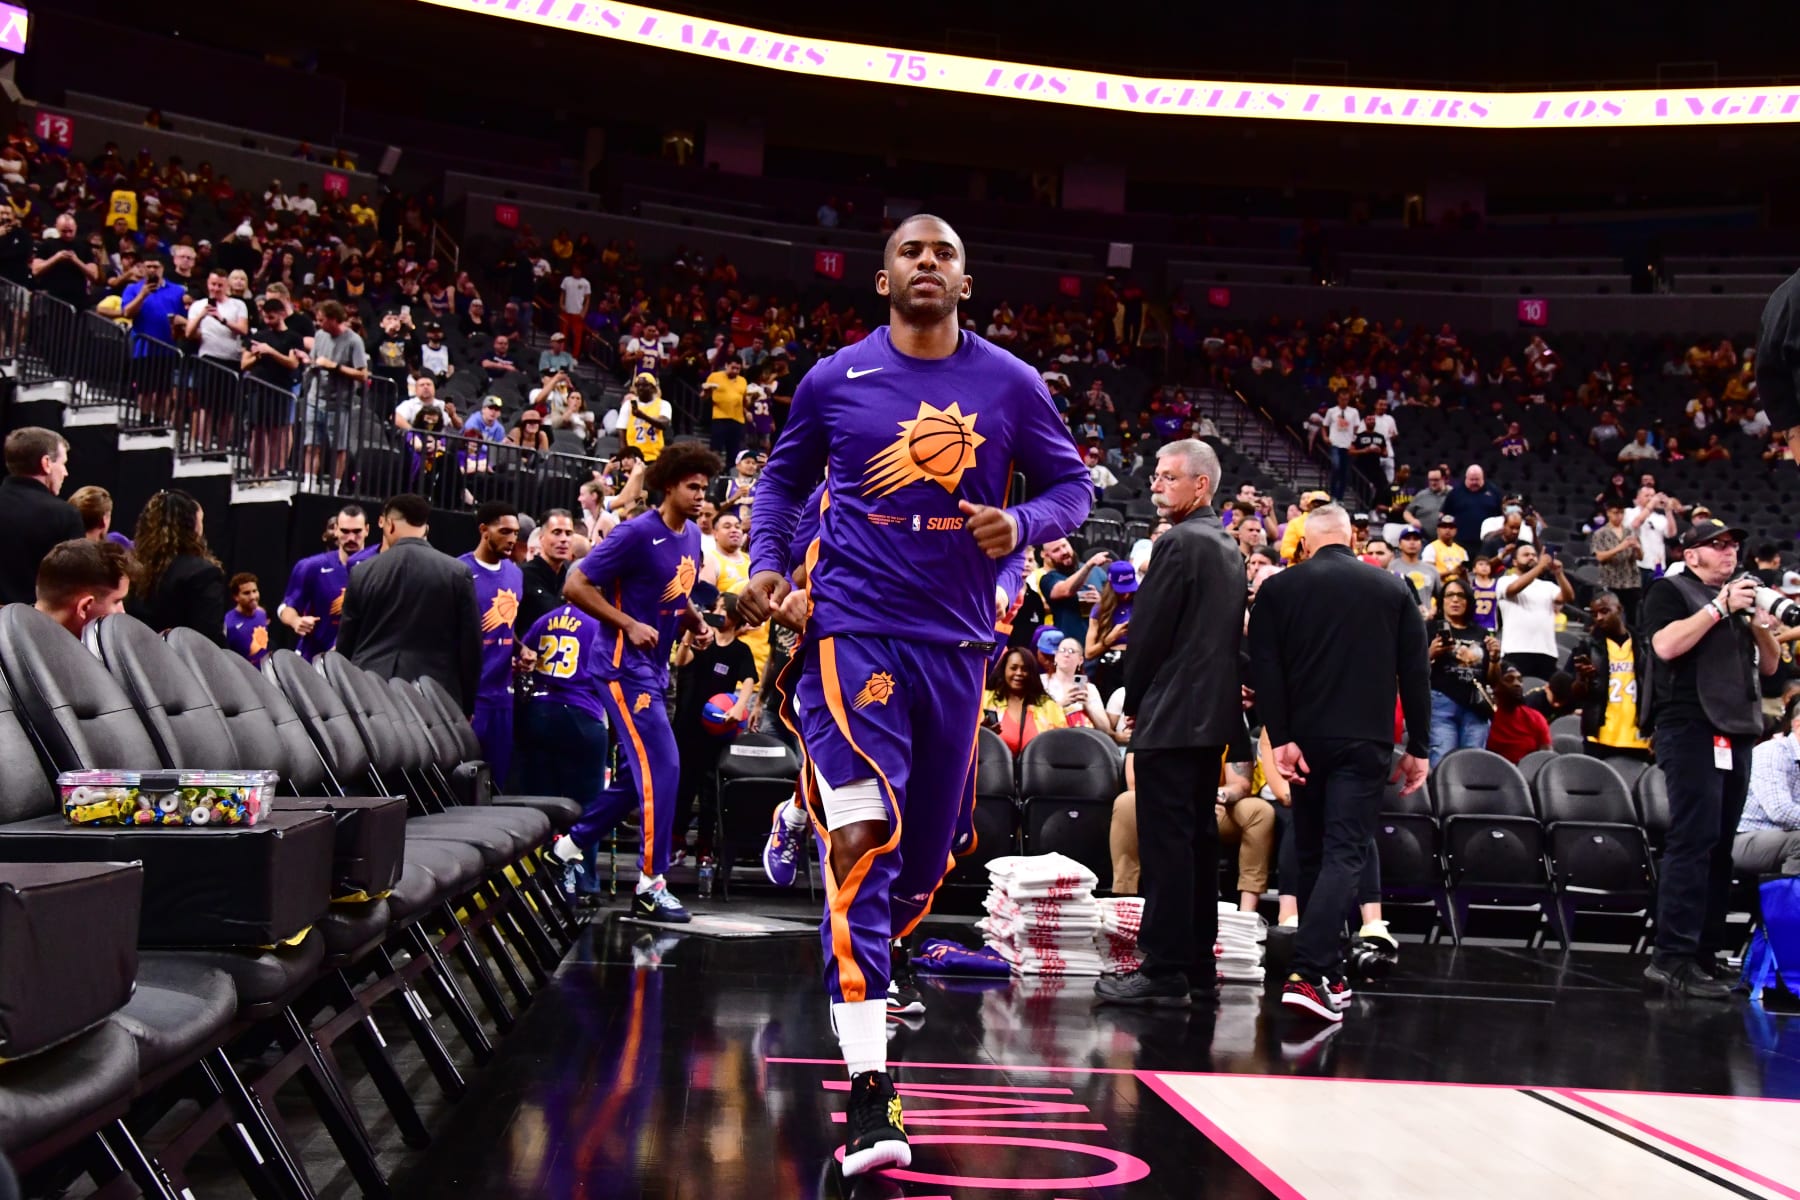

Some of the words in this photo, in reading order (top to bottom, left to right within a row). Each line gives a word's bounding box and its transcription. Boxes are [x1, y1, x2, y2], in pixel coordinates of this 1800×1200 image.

[638, 16, 829, 66] LAKERS
[886, 52, 927, 82] 75
[984, 68, 1071, 94] LOS
[1083, 80, 1290, 110] ANGELES
[1302, 93, 1492, 119] LAKERS
[1532, 99, 1627, 119] LOS
[40, 117, 69, 143] 12
[823, 255, 837, 273] 11
[1524, 303, 1541, 321] 10
[635, 424, 658, 444] 24
[547, 615, 582, 633] JAMES
[536, 634, 580, 679] 23
[1608, 678, 1638, 704] 24
